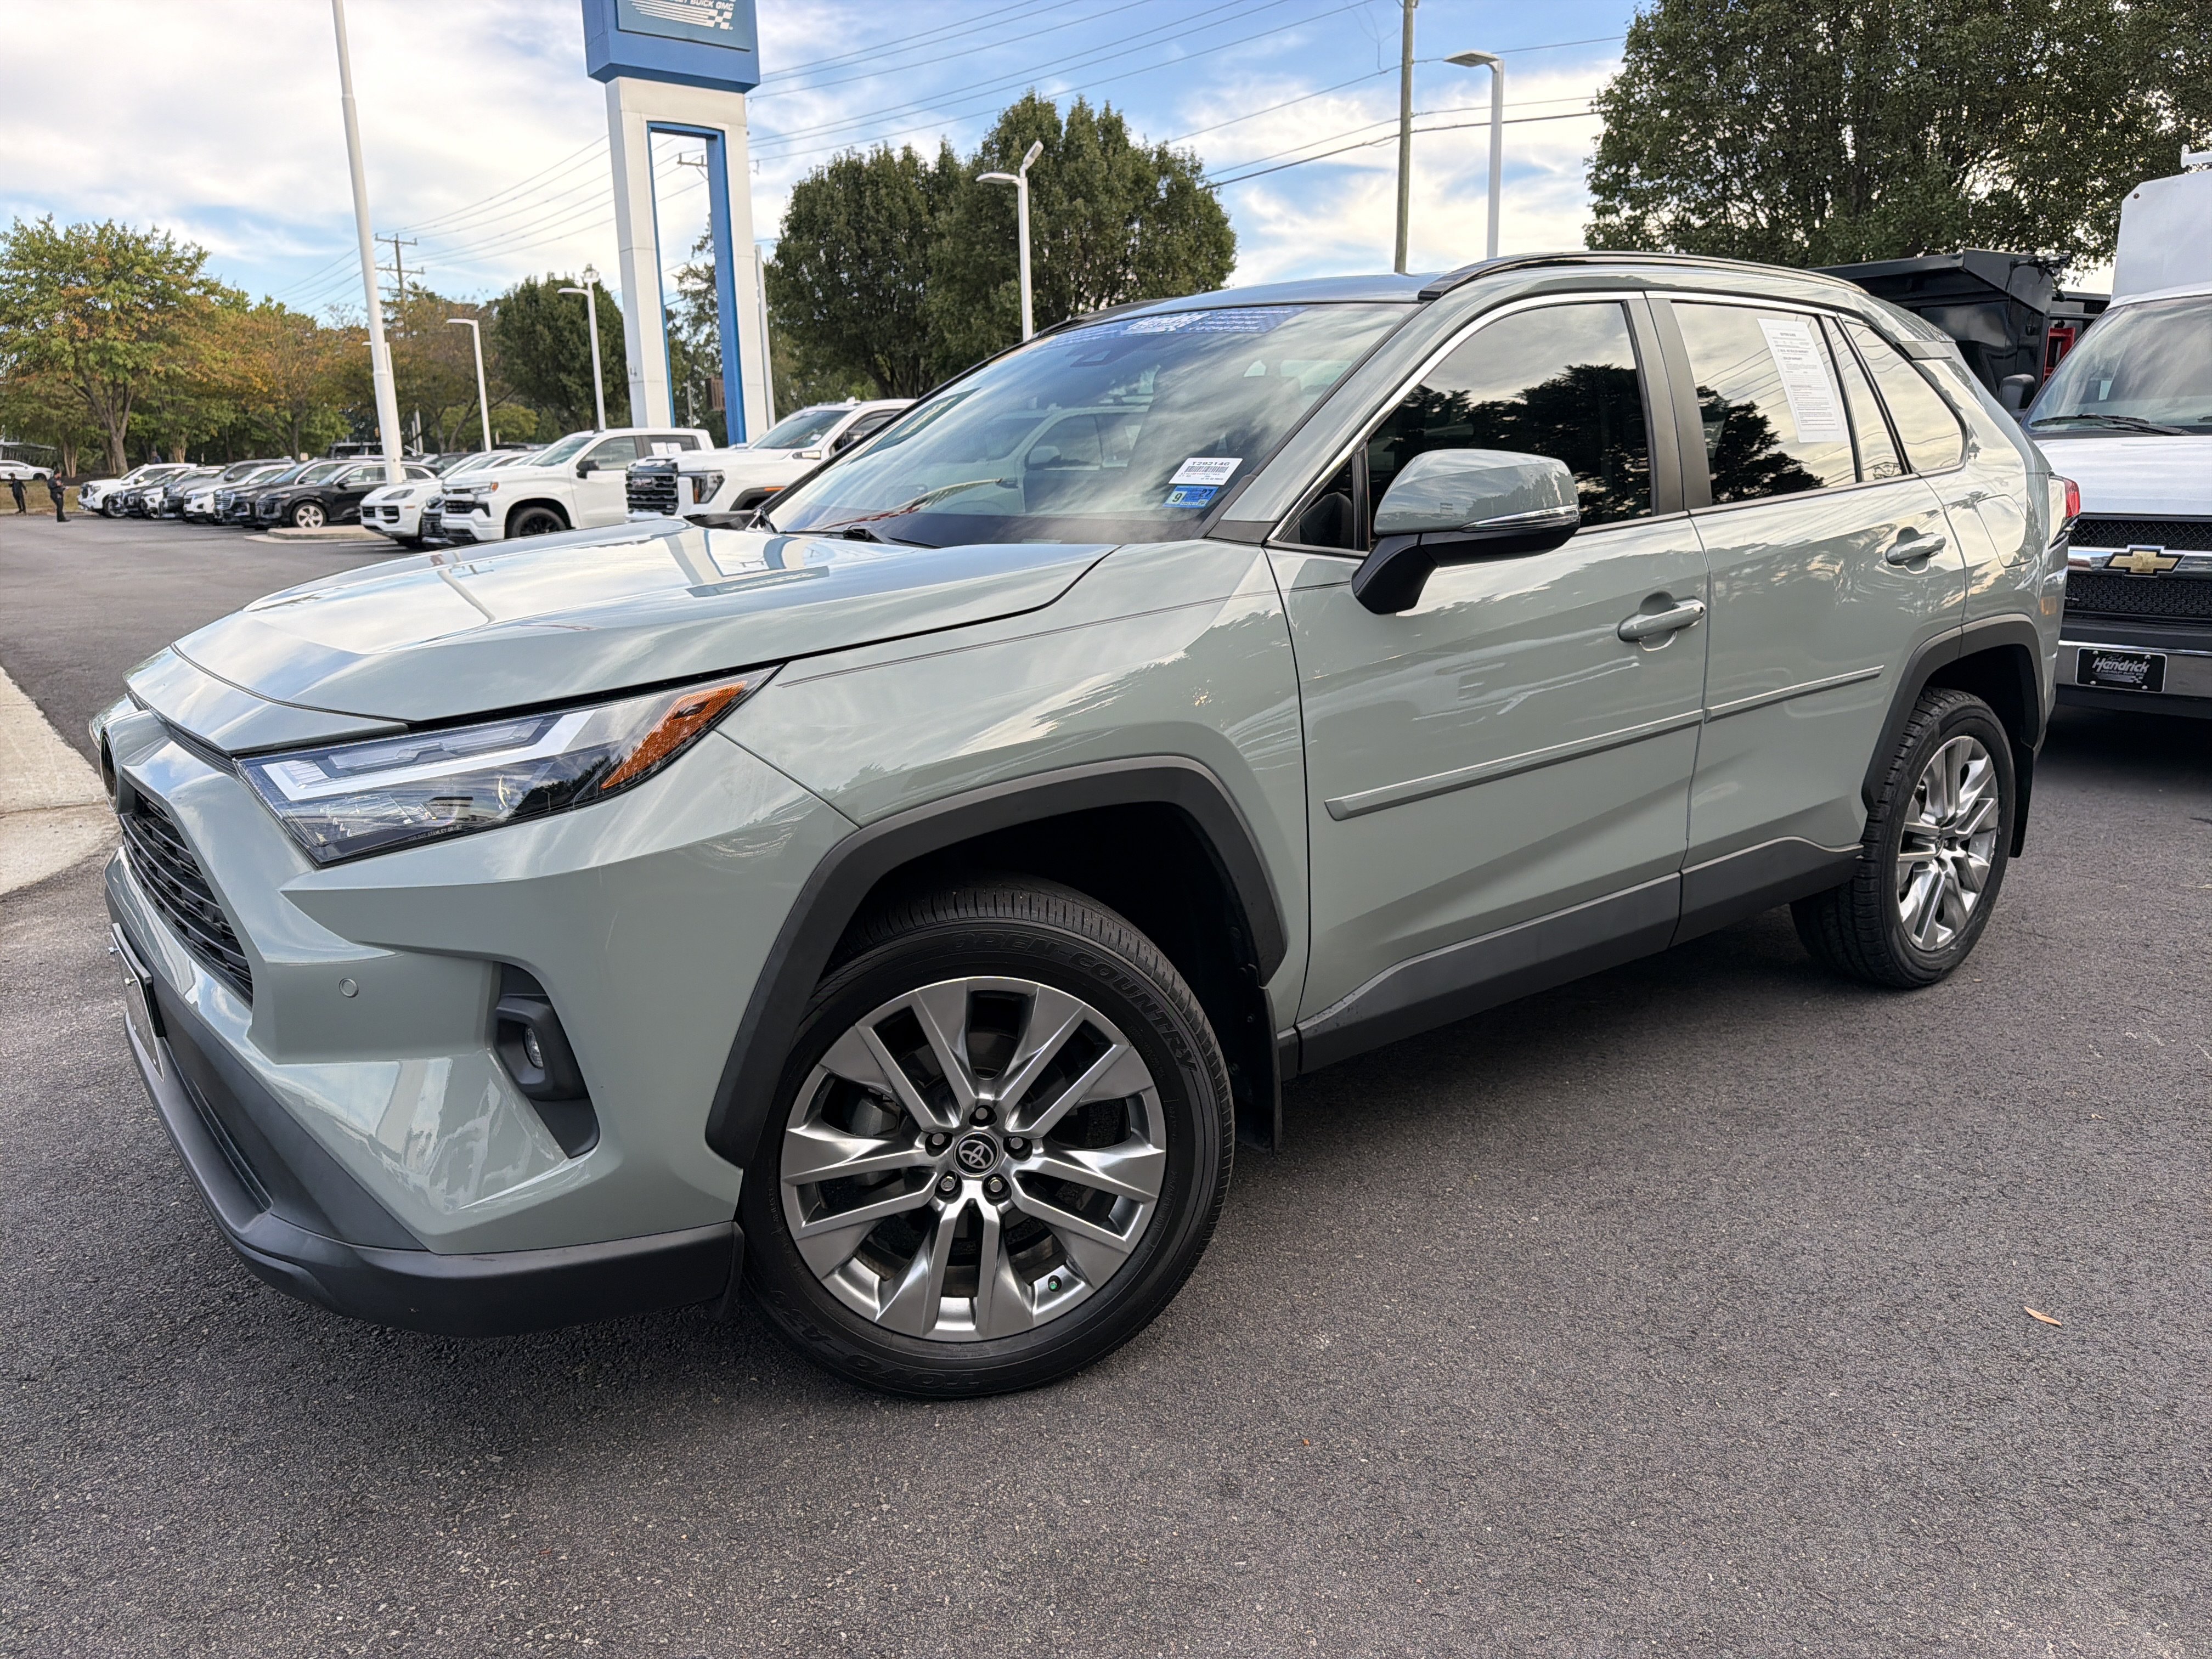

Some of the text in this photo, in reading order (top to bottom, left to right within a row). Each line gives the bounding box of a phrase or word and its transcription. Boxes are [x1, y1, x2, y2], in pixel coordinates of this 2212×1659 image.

[715, 2, 734, 11] GMC
[1172, 493, 1182, 502] 9
[2092, 657, 2150, 673] Hendrick
[947, 932, 1060, 957] OPEN
[1068, 951, 1197, 1072] COUNTRY
